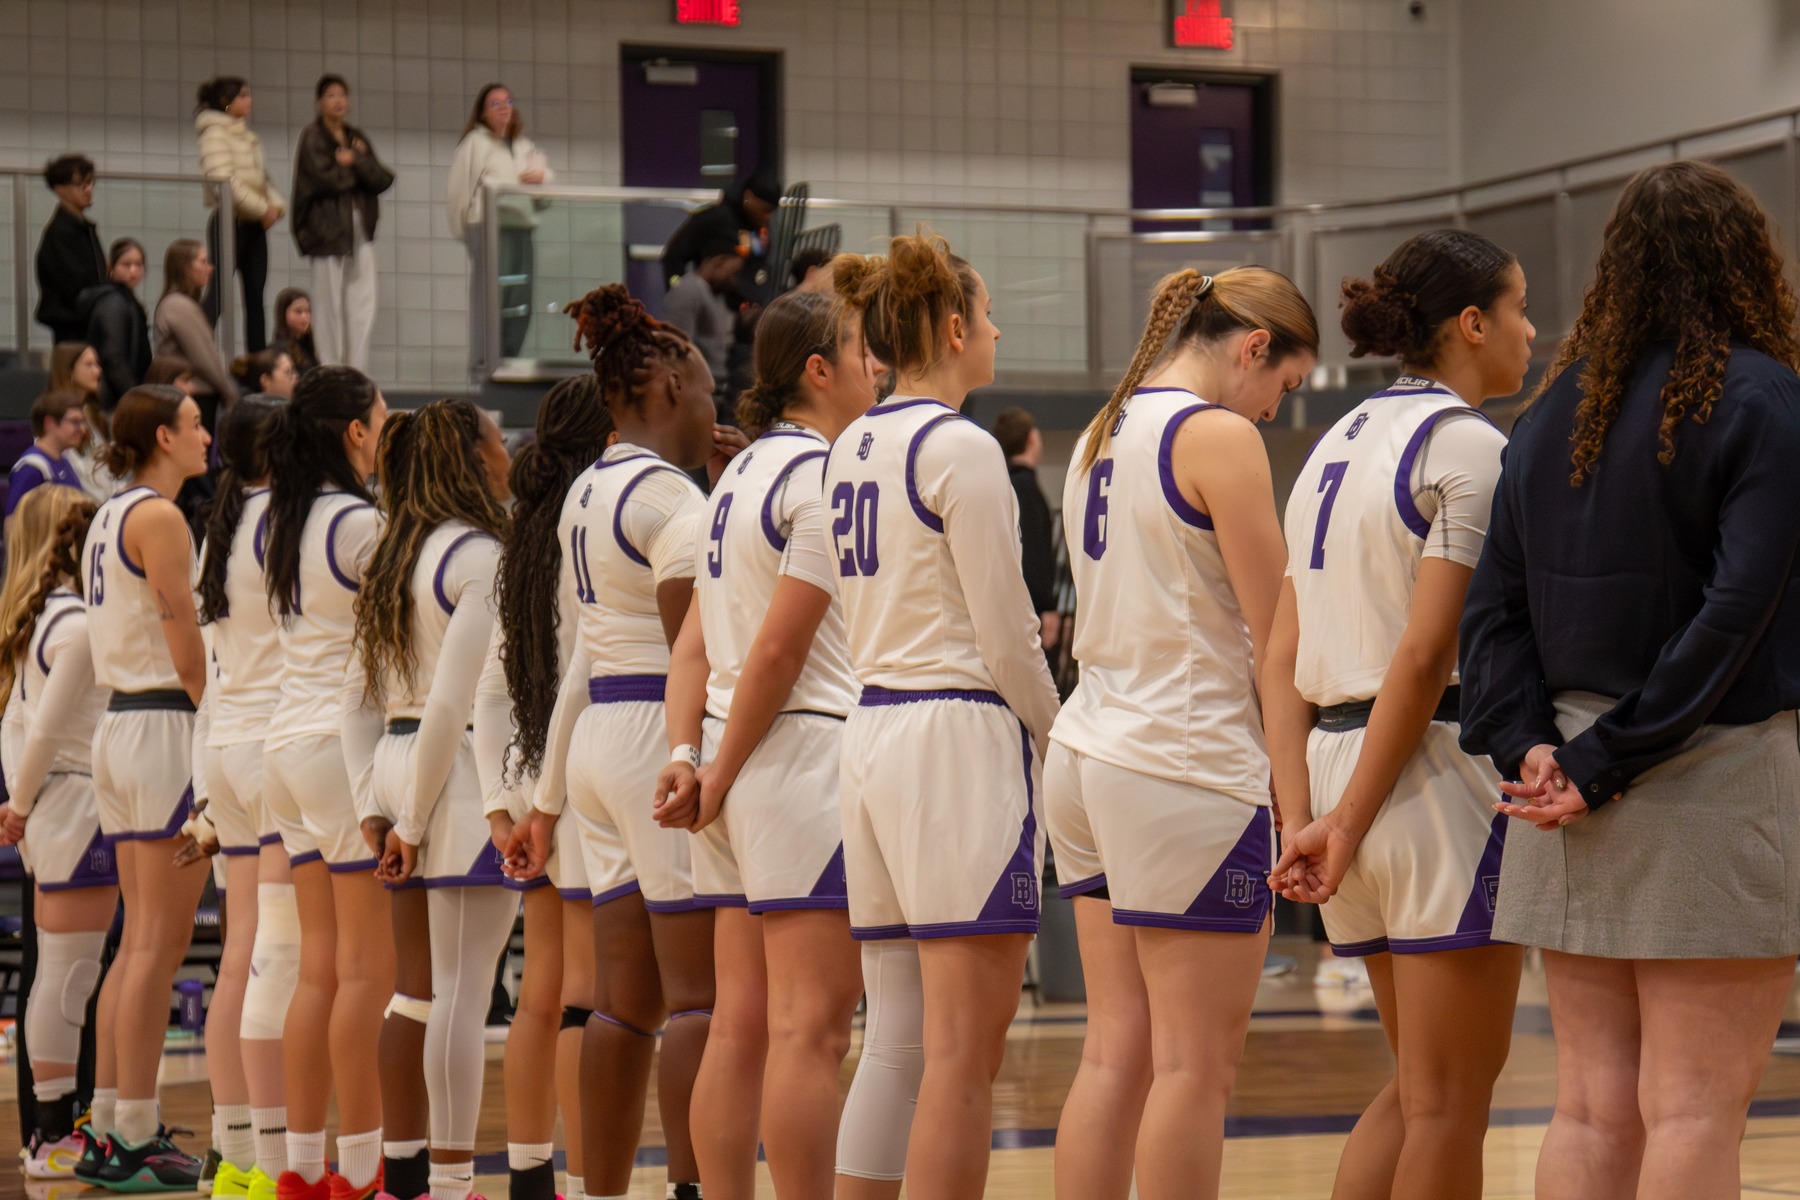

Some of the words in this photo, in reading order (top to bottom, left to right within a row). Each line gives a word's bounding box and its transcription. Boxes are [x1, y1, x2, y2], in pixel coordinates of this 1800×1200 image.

[708, 491, 733, 578] 9
[831, 480, 880, 577] 20
[1083, 458, 1114, 561] 6
[1309, 460, 1350, 570] 7
[88, 542, 106, 606] 15
[571, 524, 598, 604] 11
[1010, 872, 1038, 910] BU
[1224, 868, 1257, 909] BU
